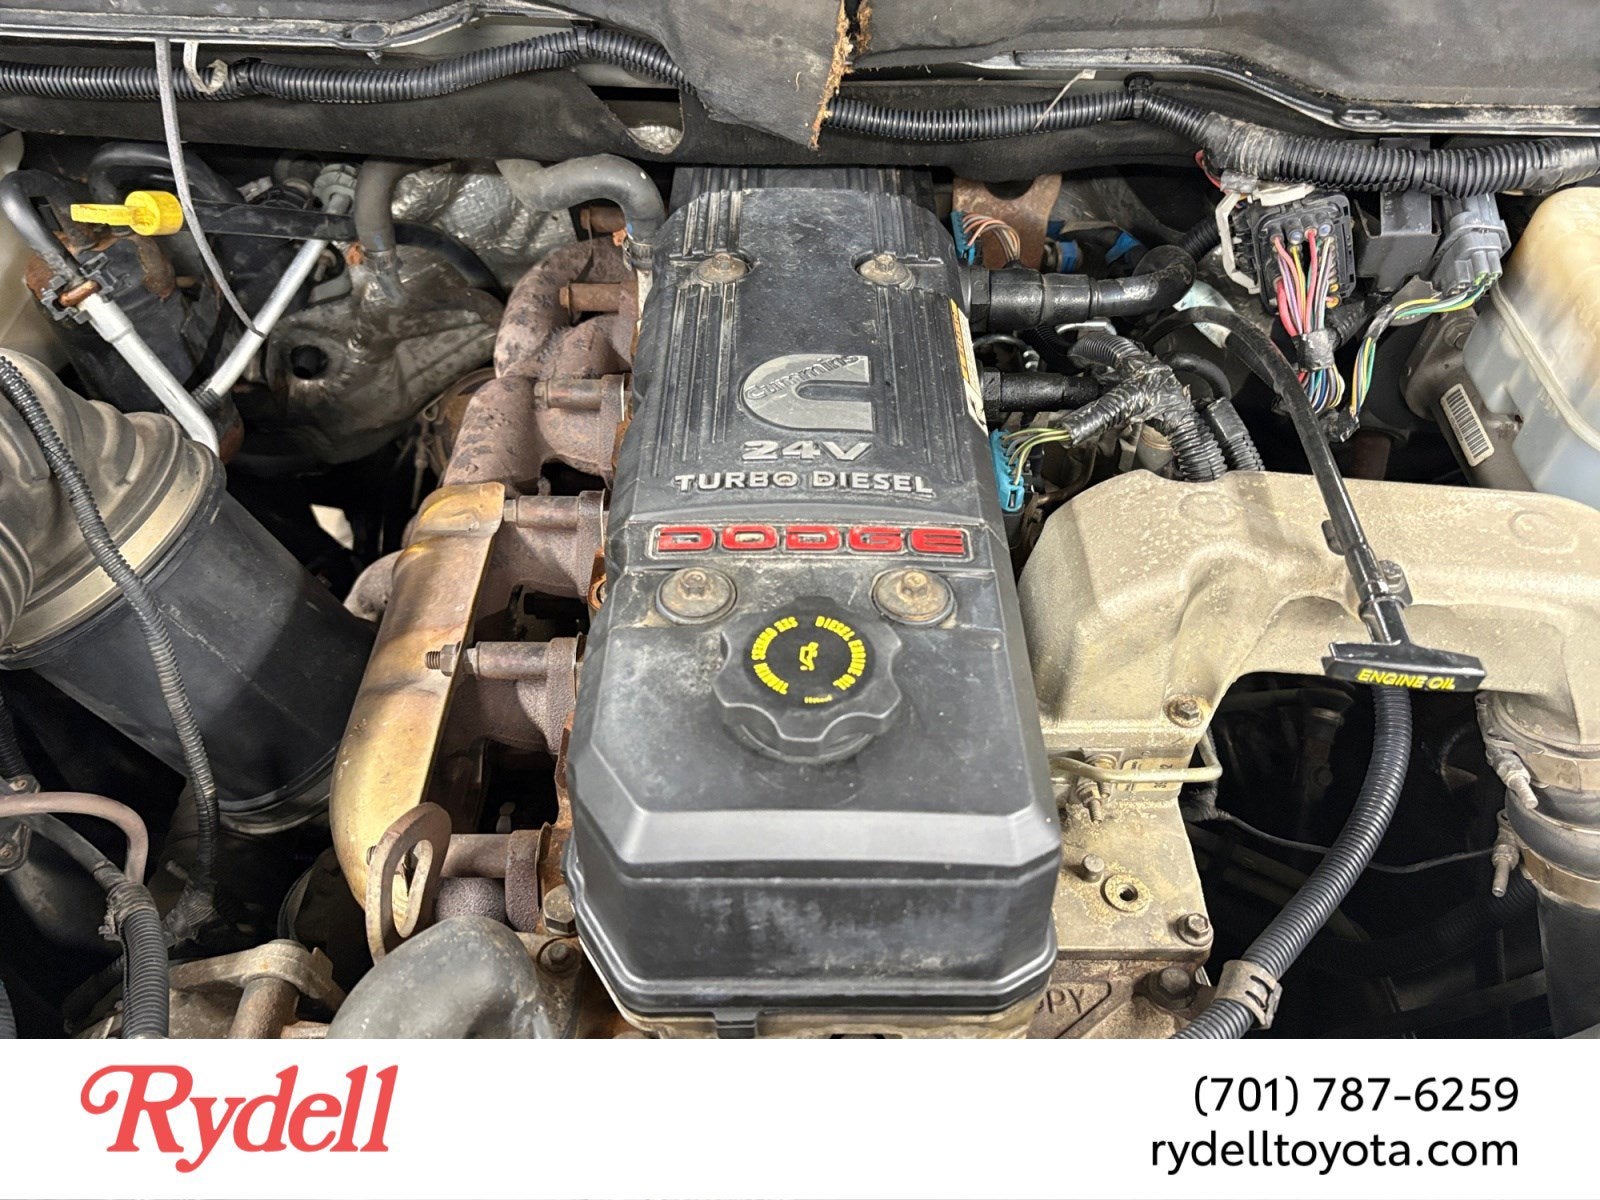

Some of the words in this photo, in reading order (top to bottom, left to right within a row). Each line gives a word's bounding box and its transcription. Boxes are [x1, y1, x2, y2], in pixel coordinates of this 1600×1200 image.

[745, 354, 860, 399] Cummins
[742, 440, 872, 461] 24V
[674, 471, 797, 491] TURBO
[812, 471, 934, 495] DIESEL
[657, 524, 965, 555] DODGE
[815, 615, 856, 642] DIESEL
[1357, 668, 1429, 689] ENGINE
[1427, 675, 1456, 690] OIL
